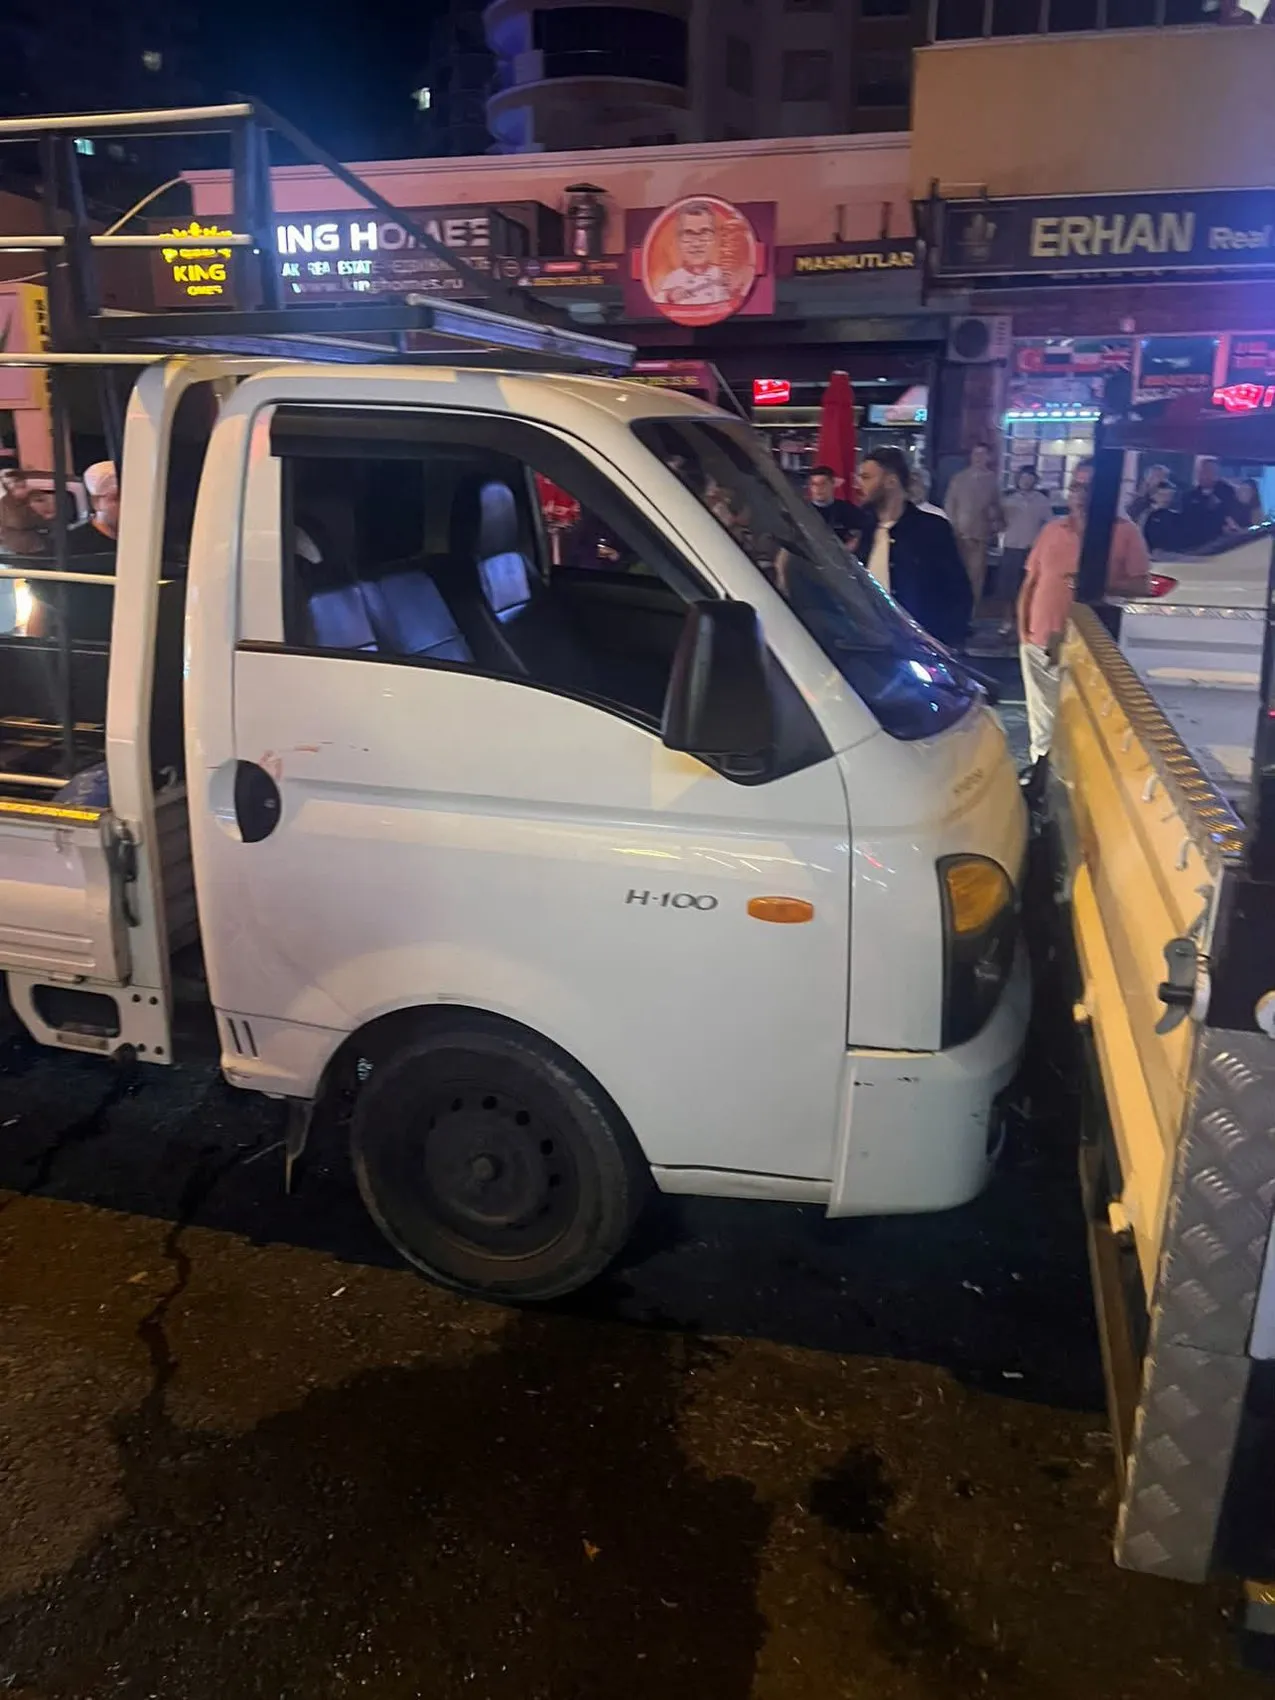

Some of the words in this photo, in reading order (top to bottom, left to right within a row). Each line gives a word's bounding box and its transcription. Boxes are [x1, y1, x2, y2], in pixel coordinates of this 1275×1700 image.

[276, 223, 341, 254] ING
[1030, 211, 1196, 257] ERHAN
[1209, 224, 1273, 249] Real
[173, 263, 226, 282] KING
[795, 250, 916, 272] MAHMUTLAR
[624, 888, 719, 911] H-100
